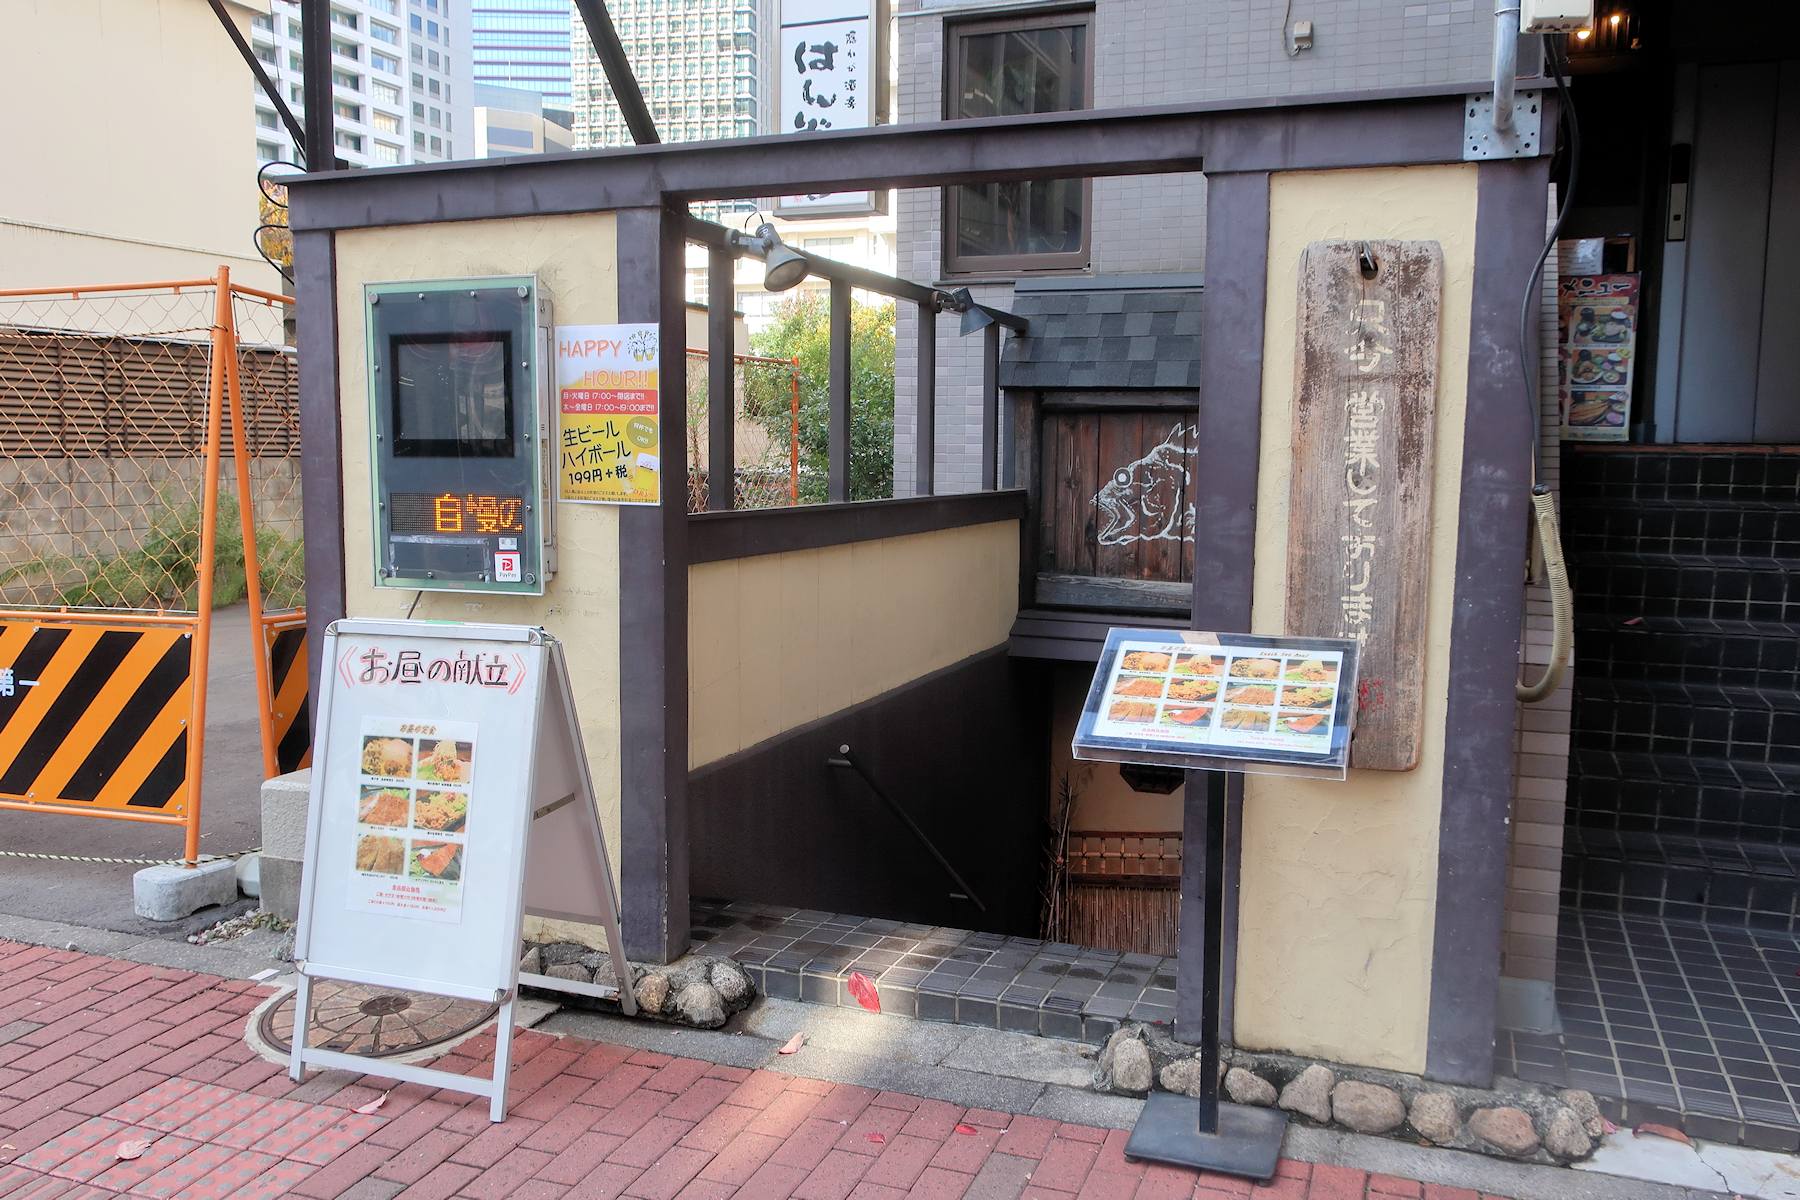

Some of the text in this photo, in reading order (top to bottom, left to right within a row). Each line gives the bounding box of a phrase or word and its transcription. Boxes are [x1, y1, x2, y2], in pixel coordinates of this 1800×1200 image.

[1561, 277, 1632, 297] メニュー
[558, 339, 622, 359] HAPPY
[582, 369, 650, 389] HOUR!!
[562, 420, 620, 448] 生ビール
[562, 440, 632, 470] ハイボール
[499, 571, 517, 579] PayPay
